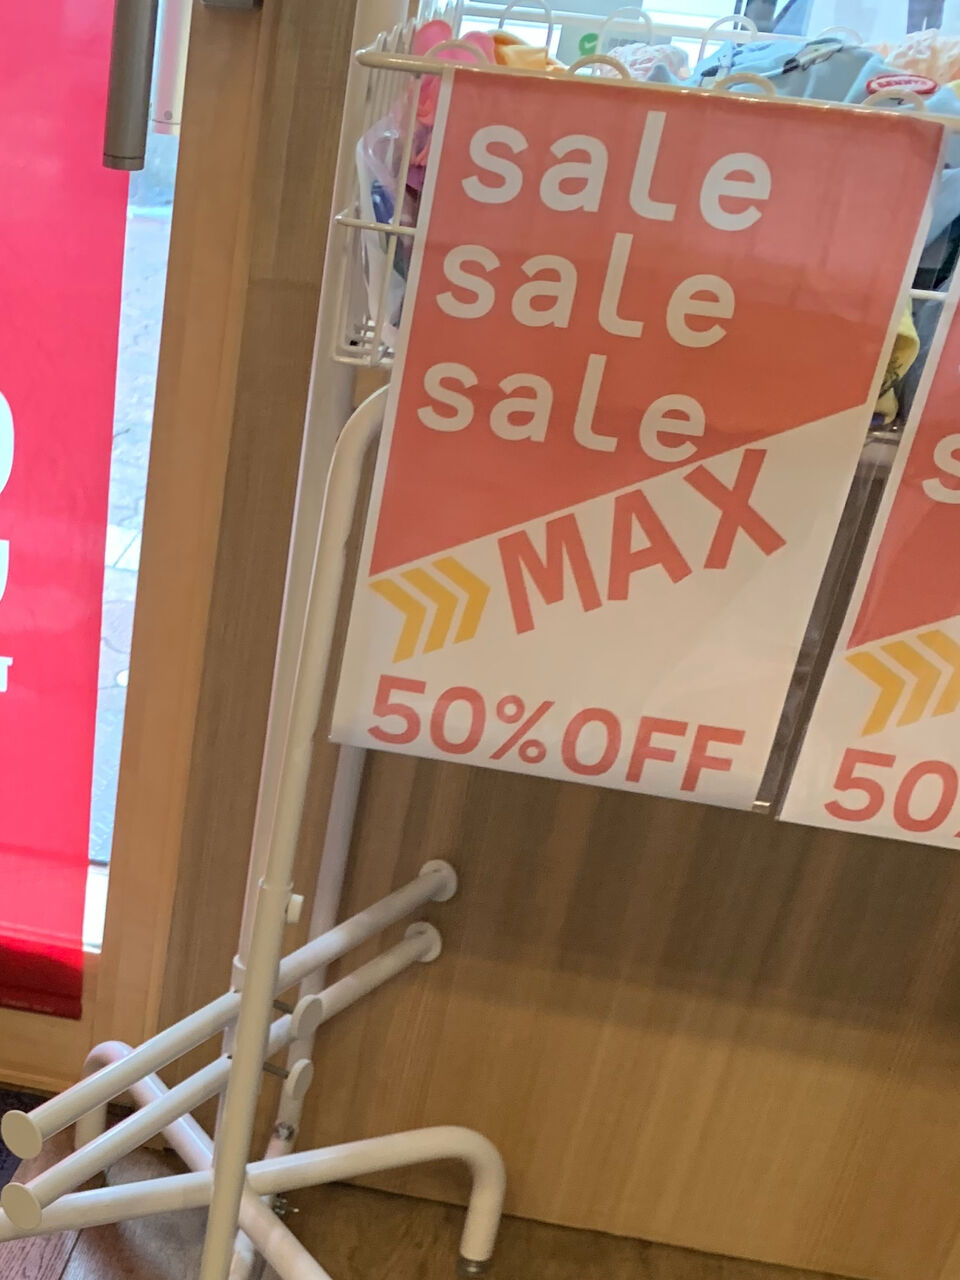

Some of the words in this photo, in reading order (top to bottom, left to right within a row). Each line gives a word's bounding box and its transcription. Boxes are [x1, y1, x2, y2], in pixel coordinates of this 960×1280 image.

[461, 109, 773, 232] sale
[435, 232, 736, 348] sale
[416, 353, 706, 464] sale
[497, 448, 786, 635] MAX
[368, 675, 745, 793] 50%OFF
[824, 747, 960, 838] 50
